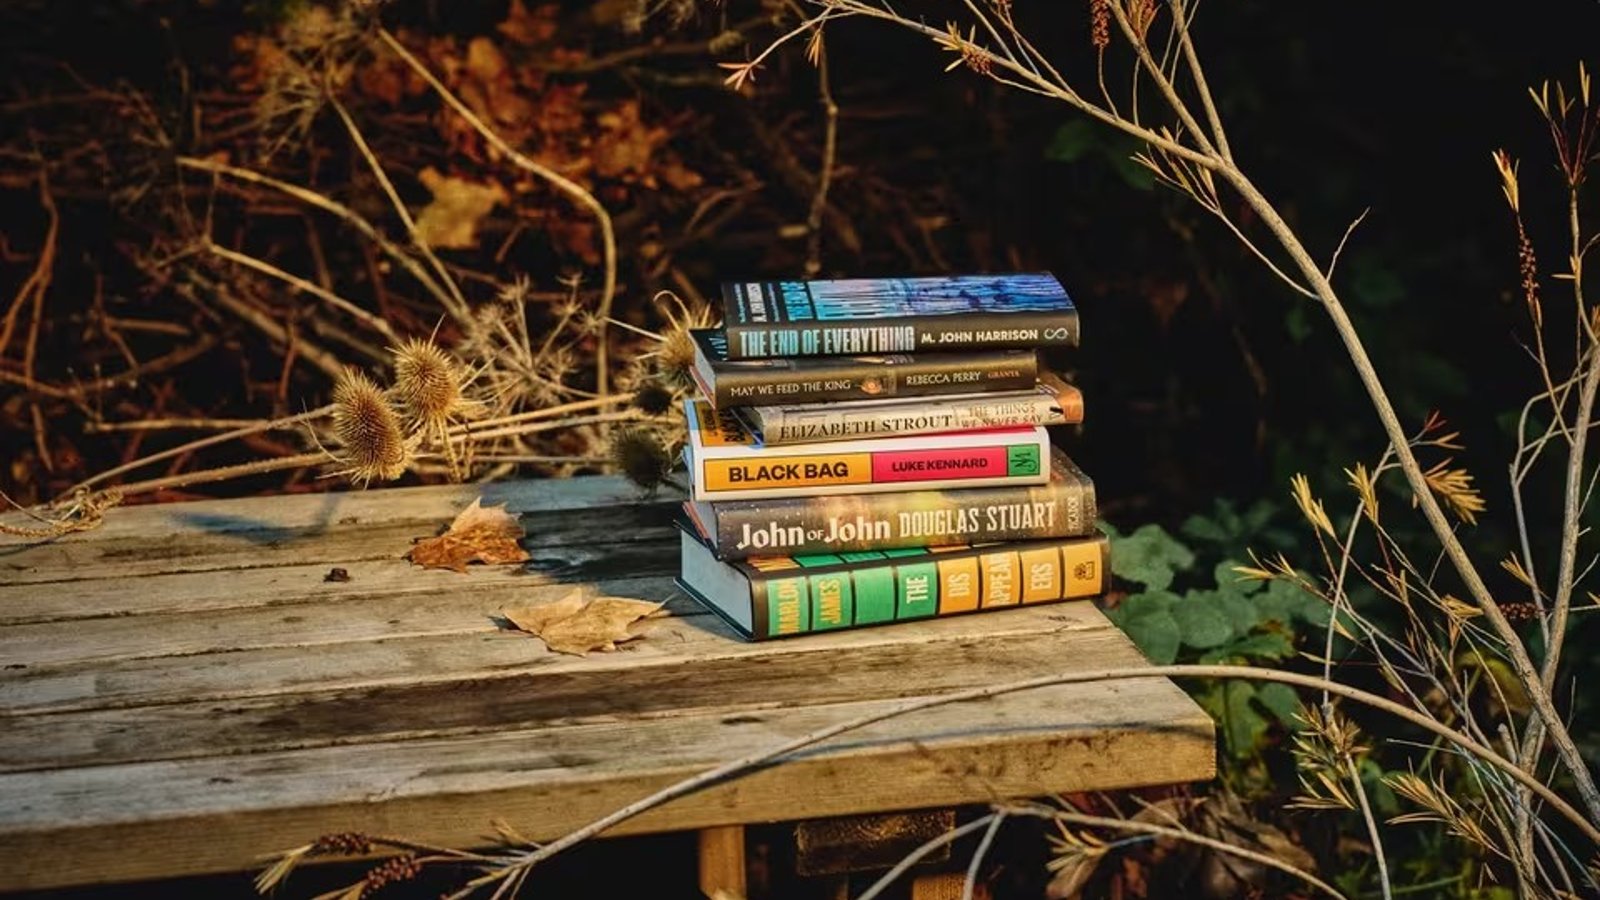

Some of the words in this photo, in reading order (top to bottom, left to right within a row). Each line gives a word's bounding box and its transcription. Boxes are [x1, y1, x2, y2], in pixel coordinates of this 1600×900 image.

[740, 329, 767, 357] THE
[770, 328, 799, 355] END
[802, 327, 821, 354] OF
[823, 326, 916, 354] EVERYTHING
[921, 332, 936, 344] M.
[938, 331, 973, 343] JOHN
[976, 329, 1039, 342] HARRISON
[730, 386, 755, 397] MAY
[757, 385, 774, 395] WE
[776, 384, 800, 394] FEED
[802, 382, 822, 392] THE
[824, 380, 851, 391] KING
[906, 373, 950, 386] REBECCA
[953, 371, 981, 383] PERRY
[968, 406, 987, 418] THE
[996, 402, 1036, 415] THINGS
[780, 420, 876, 440] ELIZABETH
[881, 415, 953, 431] STROUT
[983, 416, 1017, 426] NEVER
[1023, 415, 1042, 423] SAY
[729, 464, 800, 482] BLACK
[804, 462, 848, 478] BAG
[892, 462, 925, 472] LUKE
[927, 458, 988, 470] KENNARD
[899, 507, 979, 538] DOUGLAS
[986, 501, 1056, 532] STUART
[736, 521, 804, 550] John
[806, 530, 825, 541] OF
[823, 515, 891, 543] John
[906, 574, 928, 605] THE
[947, 572, 971, 598] DIS
[1031, 562, 1054, 591] ERS
[819, 579, 841, 625] JAMES
